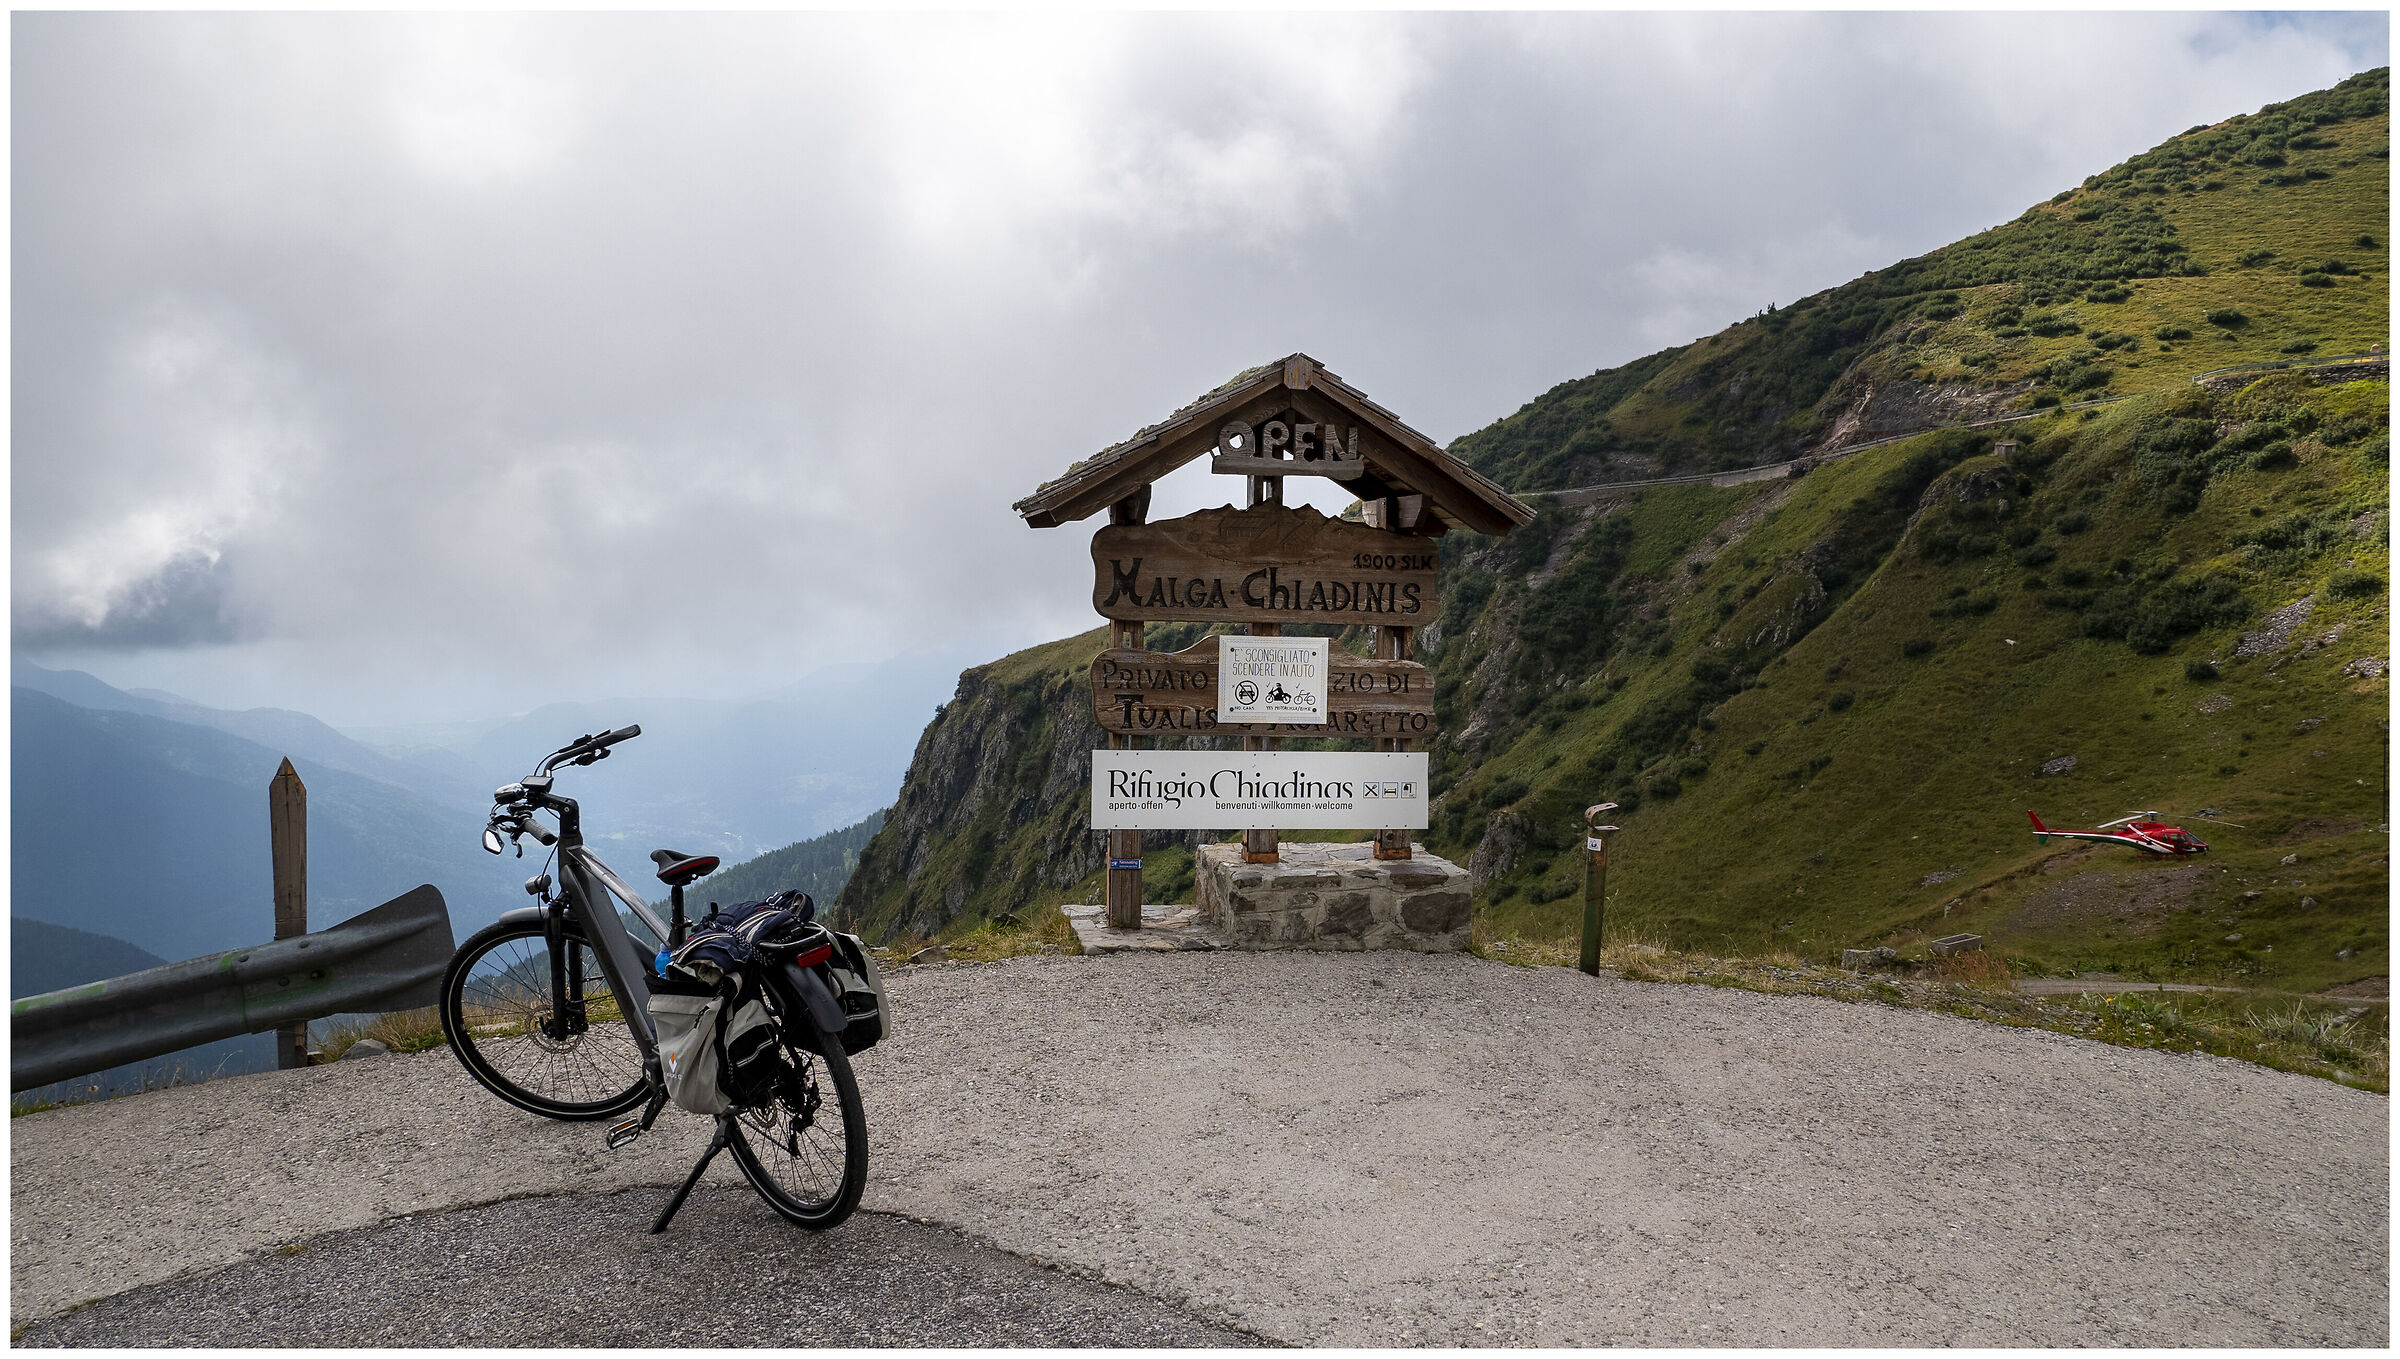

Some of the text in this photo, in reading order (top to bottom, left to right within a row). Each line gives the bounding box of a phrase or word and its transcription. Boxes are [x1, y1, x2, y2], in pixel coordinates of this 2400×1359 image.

[1219, 421, 1358, 461] OPEN
[1353, 553, 1396, 569] 1900
[1232, 663, 1315, 678] SCENDERE IN AUTO
[1245, 649, 1310, 663] SCONSIGLIATO
[1102, 659, 1209, 690] PRIVATO
[1386, 674, 1410, 694] DI
[1113, 694, 1218, 730] TUALIS
[1107, 769, 1353, 810] Rifugio Chiadinas
